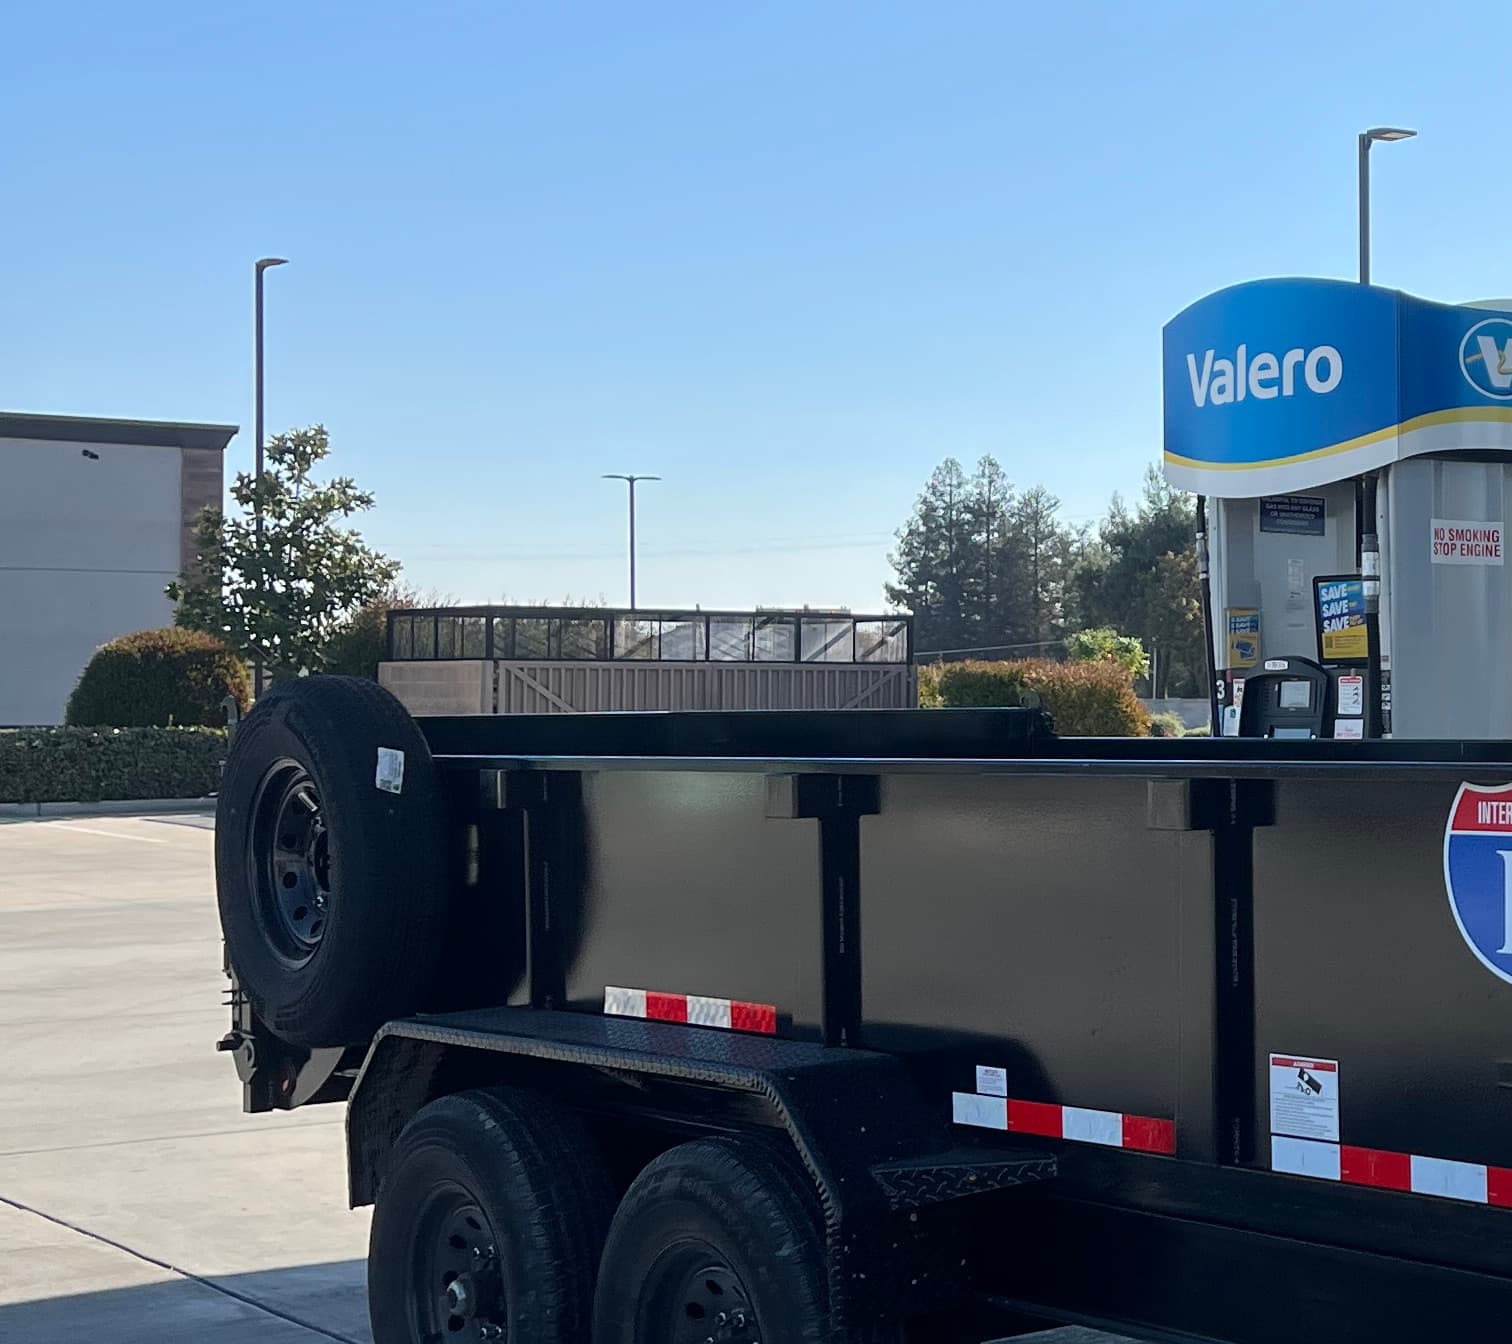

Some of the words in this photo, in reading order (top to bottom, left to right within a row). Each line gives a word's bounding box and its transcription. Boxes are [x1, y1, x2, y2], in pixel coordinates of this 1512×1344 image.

[1187, 344, 1343, 407] Valero
[1434, 528, 1445, 541] NO
[1448, 528, 1500, 543] SMOKING
[1433, 542, 1457, 556] STOP
[1460, 543, 1501, 558] ENGINE
[1321, 584, 1348, 601] SAVE
[1322, 600, 1349, 617] SAVE
[1323, 616, 1350, 633] SAVE
[1216, 680, 1225, 699] 3
